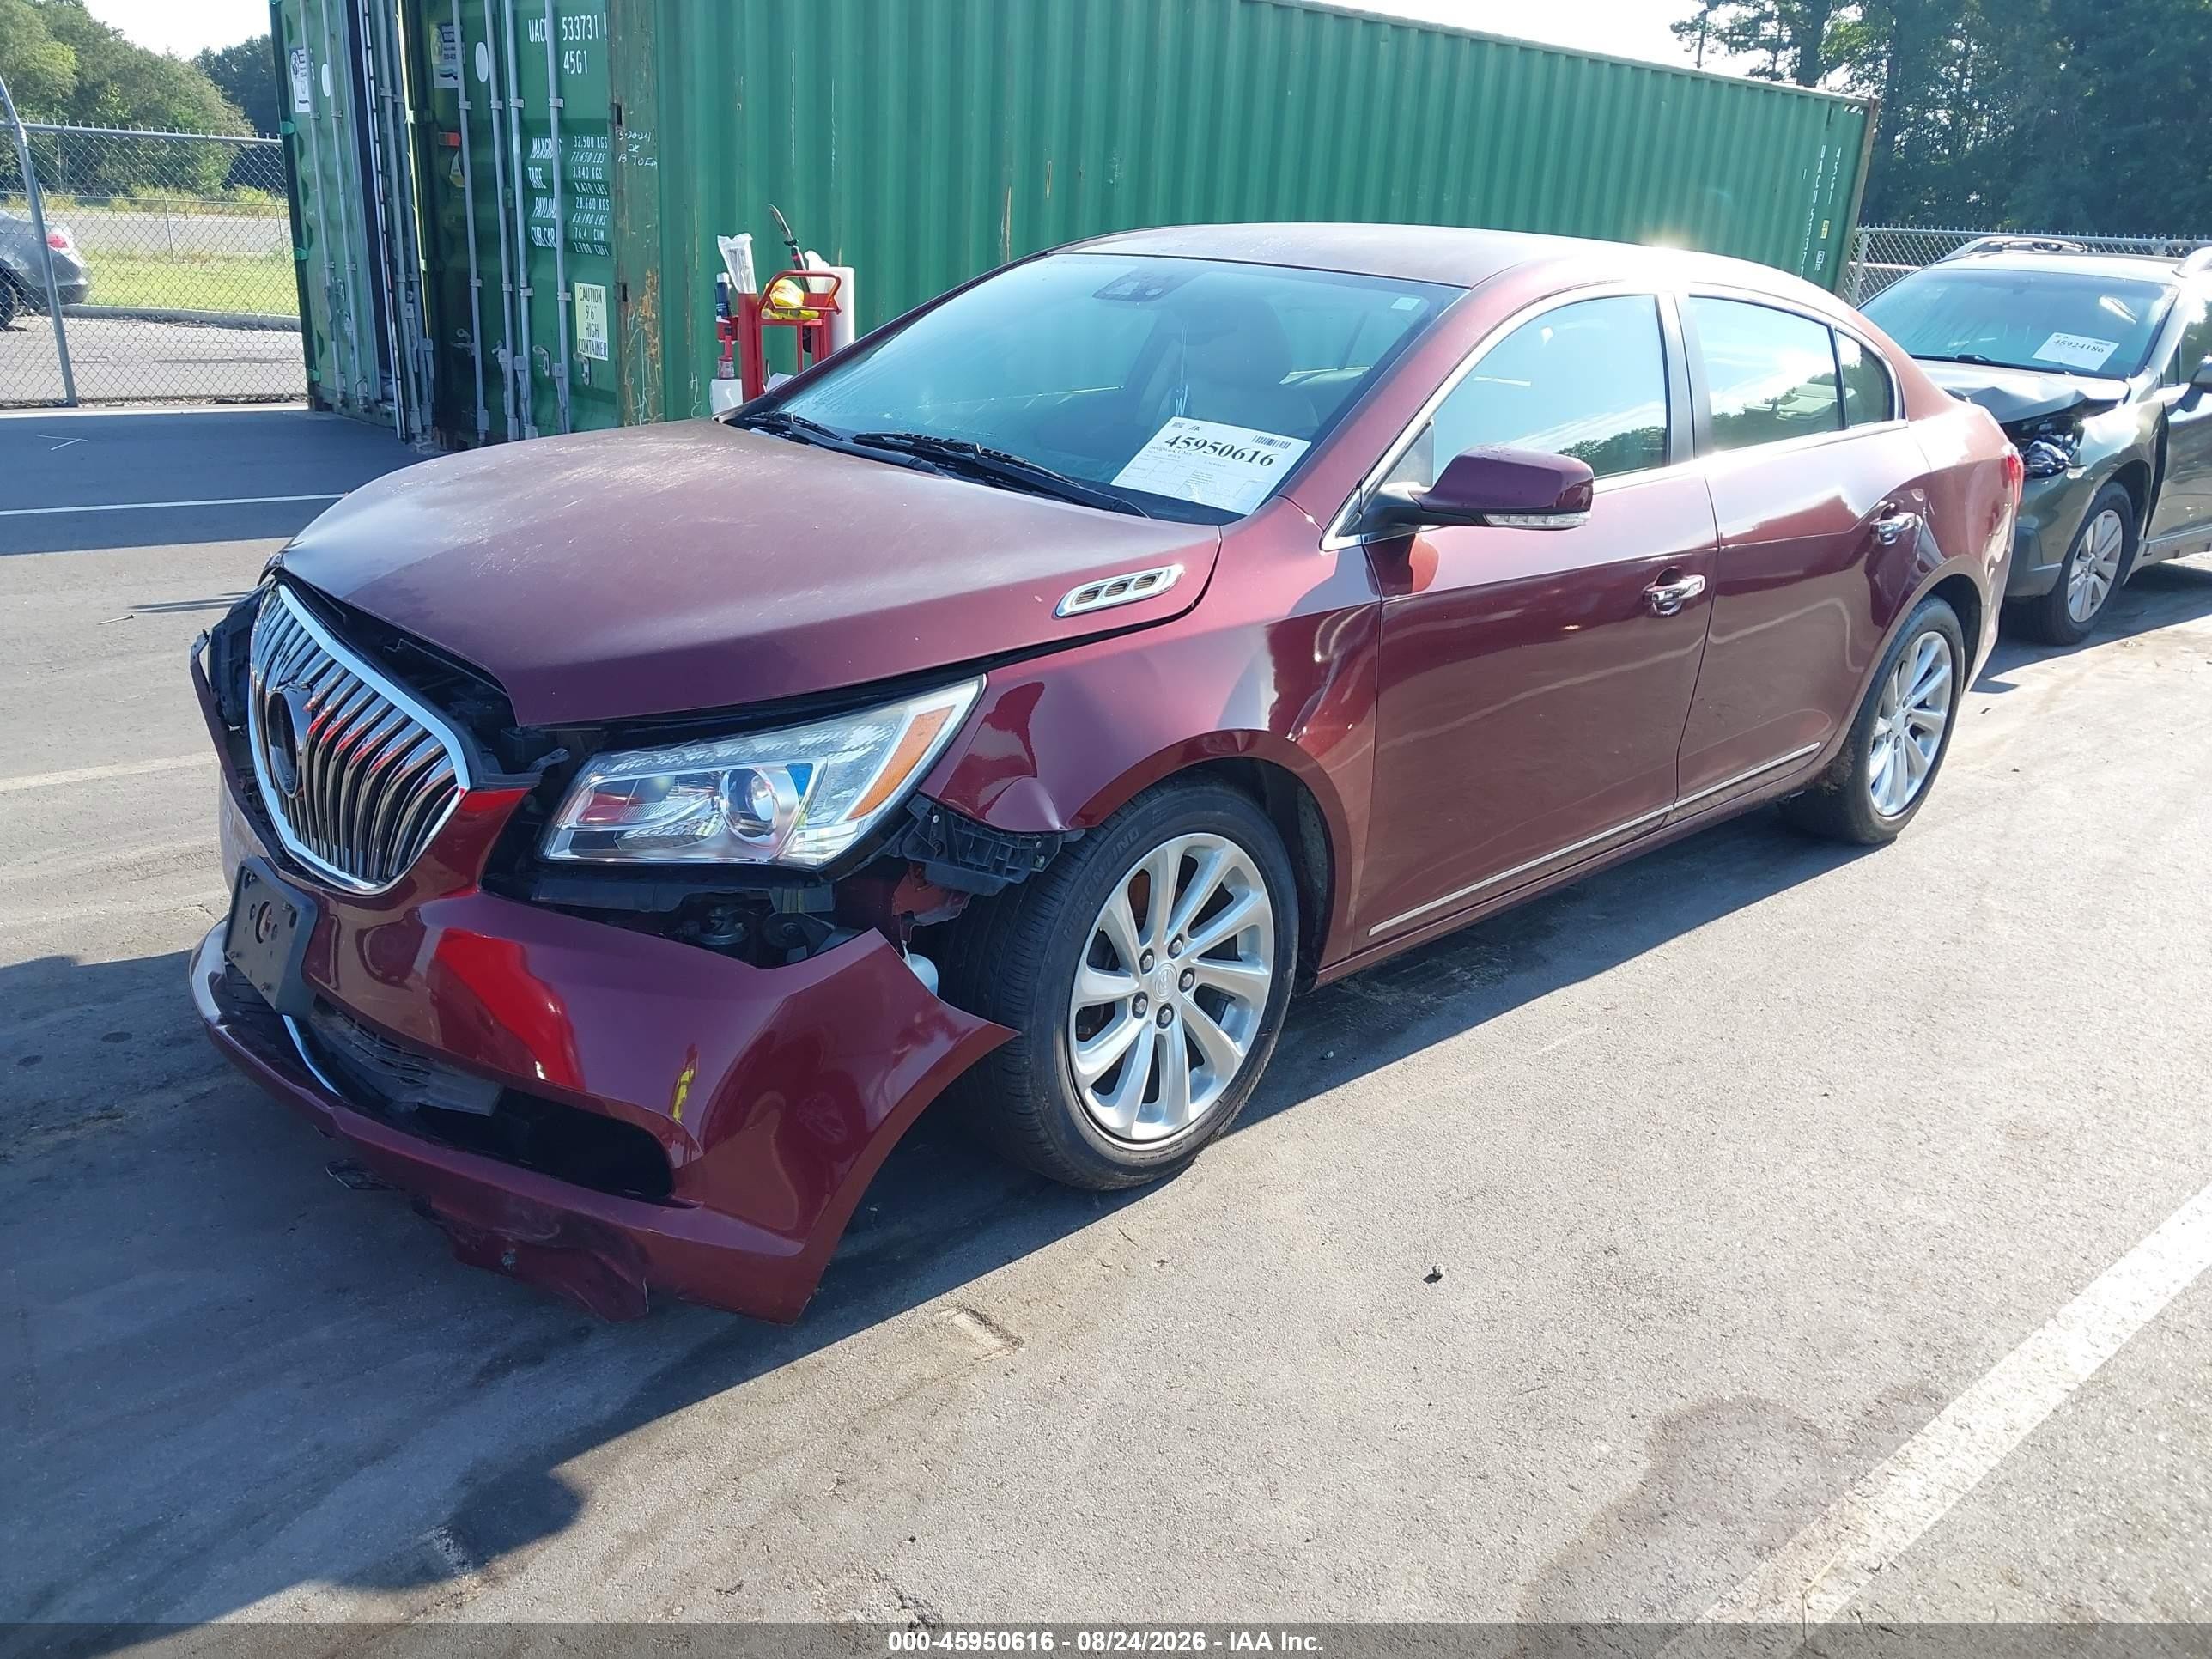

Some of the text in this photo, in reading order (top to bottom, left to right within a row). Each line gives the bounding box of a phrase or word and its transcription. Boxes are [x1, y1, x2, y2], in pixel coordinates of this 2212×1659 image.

[528, 19, 548, 42] UAC
[562, 15, 599, 41] 533731
[563, 50, 588, 75] 45G1
[574, 135, 594, 149] 32.500
[597, 136, 608, 149] KGS
[592, 152, 606, 163] LBS
[592, 167, 603, 180] KGS
[593, 183, 608, 196] LBS
[599, 198, 610, 211] KGS
[594, 214, 608, 226] LBS
[579, 286, 603, 303] CAUTION
[585, 321, 599, 338] HIGH
[578, 338, 608, 357] CONTAINER
[1164, 434, 1279, 467] 45950616
